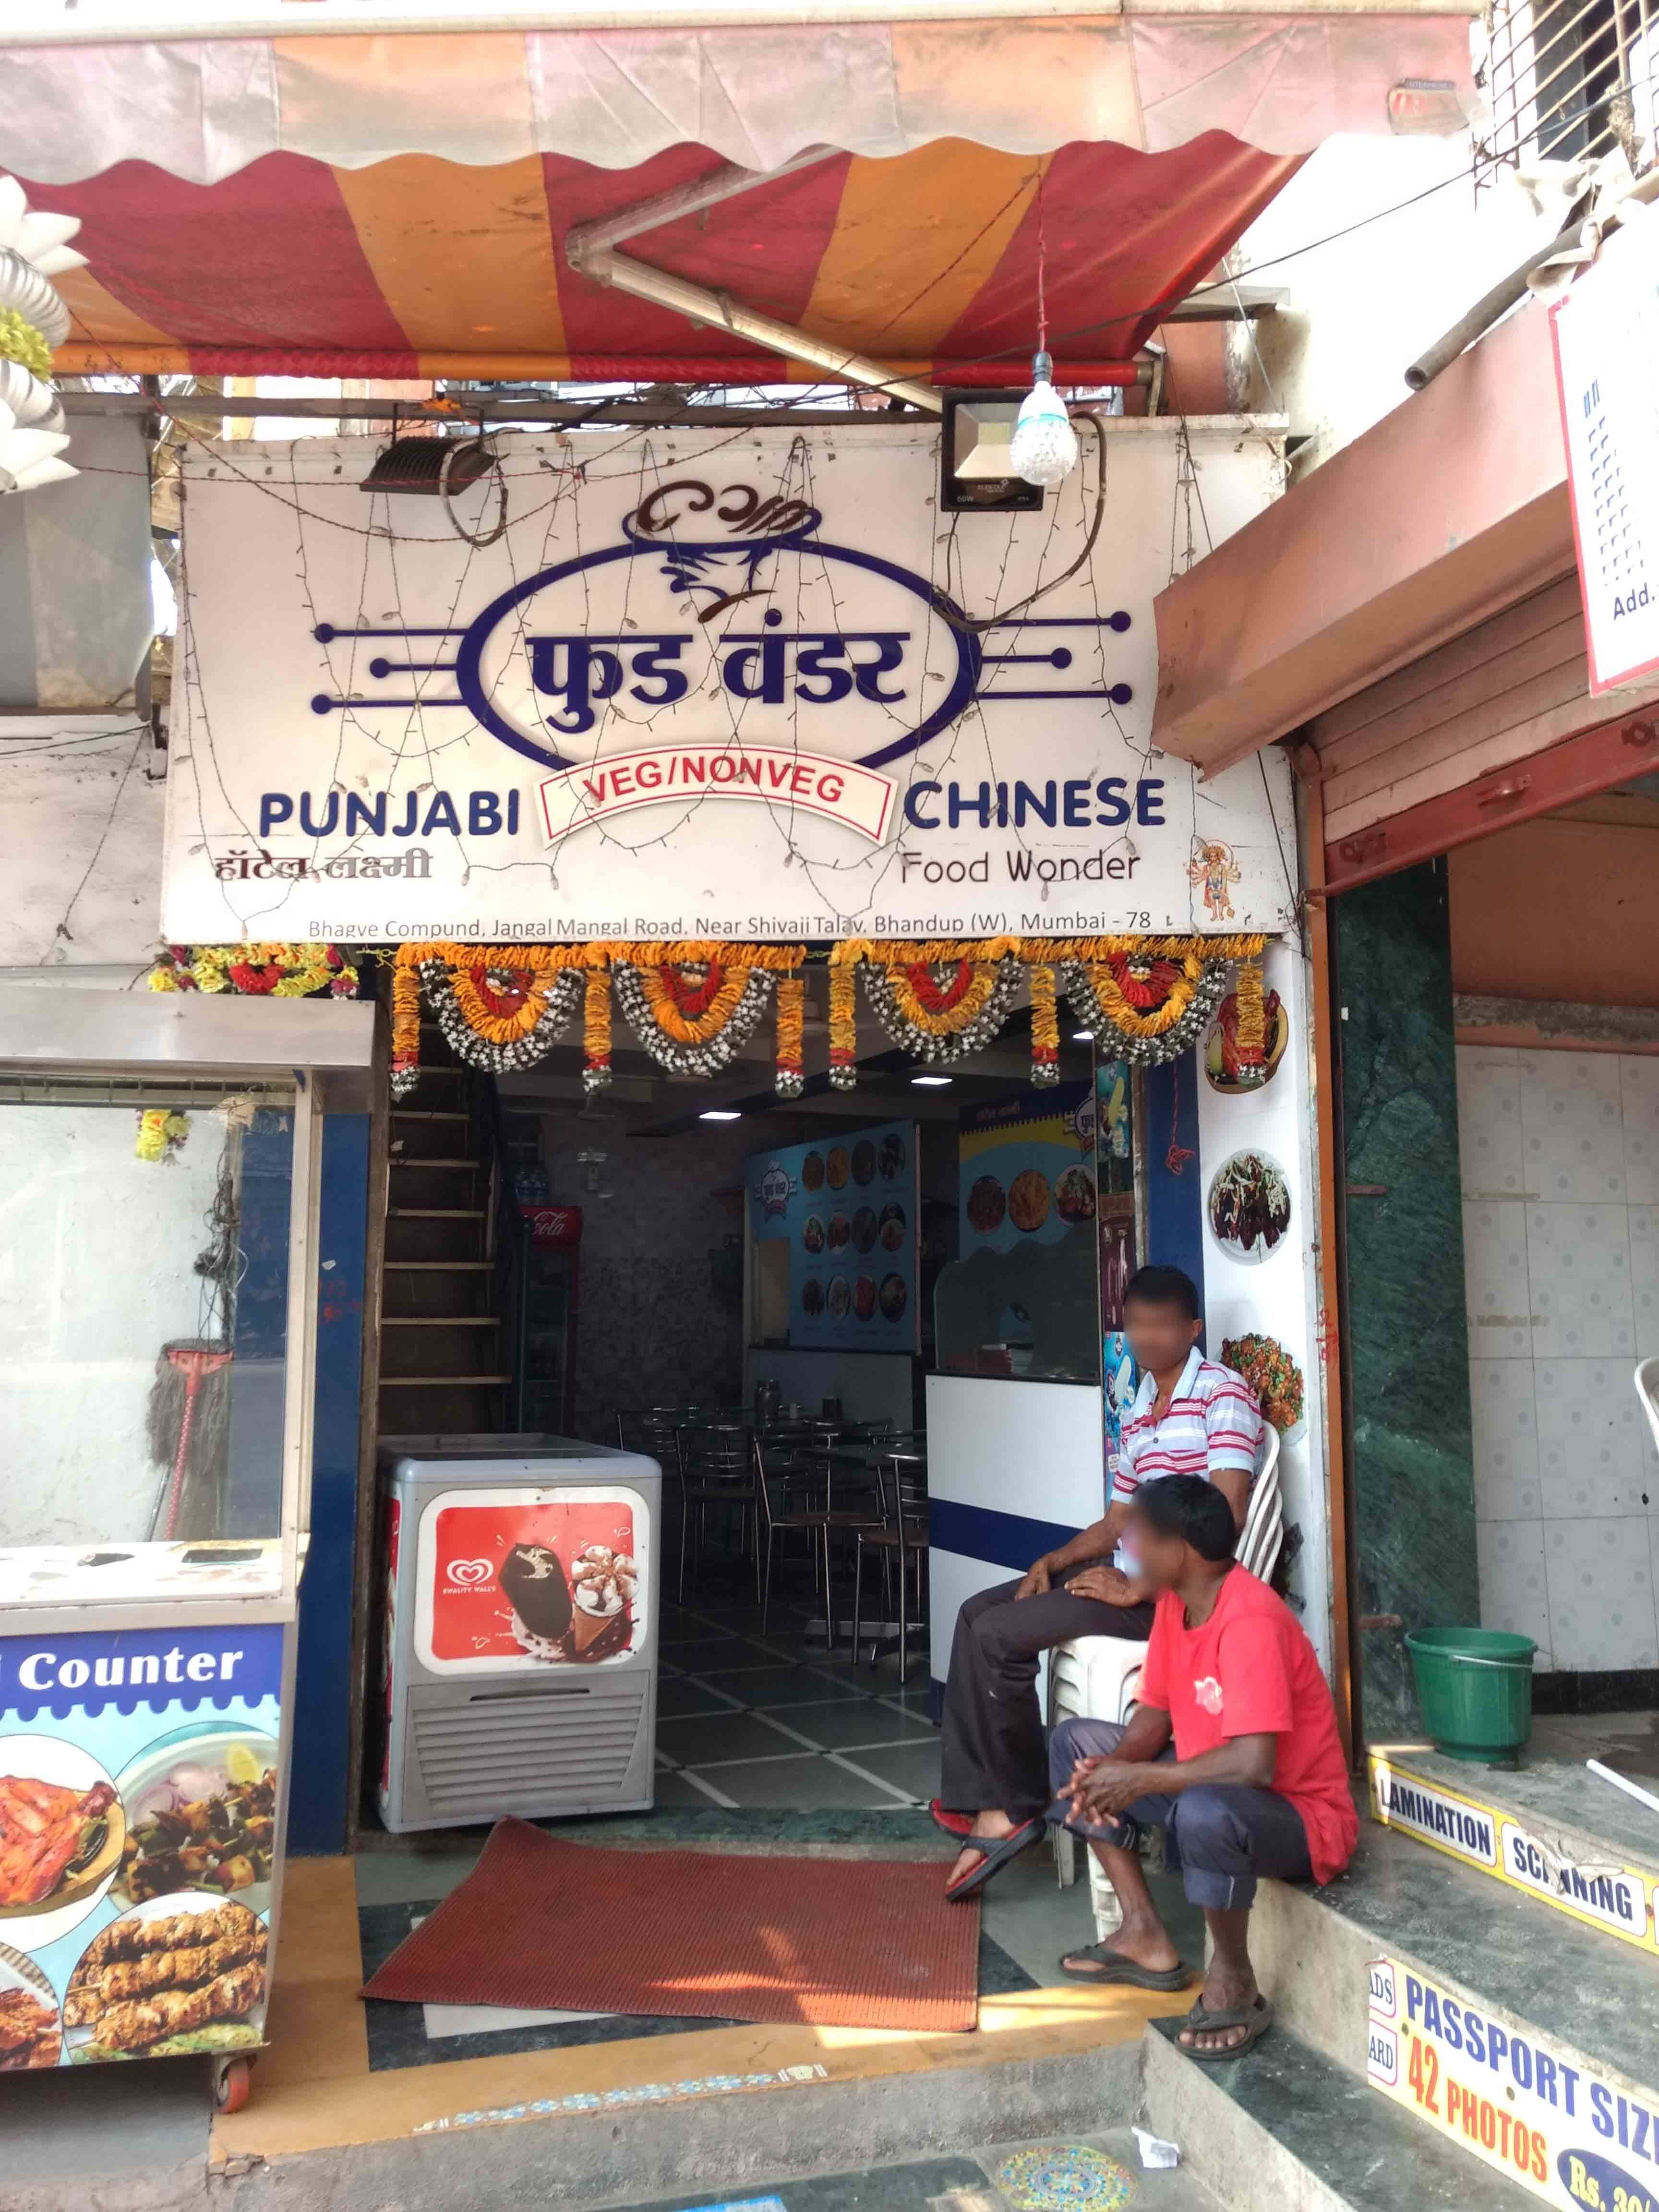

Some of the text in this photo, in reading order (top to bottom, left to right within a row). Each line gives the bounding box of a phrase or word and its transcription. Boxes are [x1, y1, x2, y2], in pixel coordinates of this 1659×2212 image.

[524, 608, 911, 733] फुड वंडर
[582, 756, 845, 803] VEG/NONVEG
[903, 778, 1166, 829] CHINESE
[260, 788, 519, 838] PUNJABI
[901, 849, 1140, 883] Food Wonder
[696, 917, 742, 934] Near
[1022, 912, 1106, 930] Mumbai
[1126, 912, 1151, 929] 78
[19, 1647, 243, 1690] Counter
[1380, 1779, 1491, 1857] LAMINATION
[1406, 1974, 1579, 2118] PASSPORT
[1409, 2035, 1548, 2183] 42 PHOTOS
[1569, 2154, 1606, 2212] Rs.
